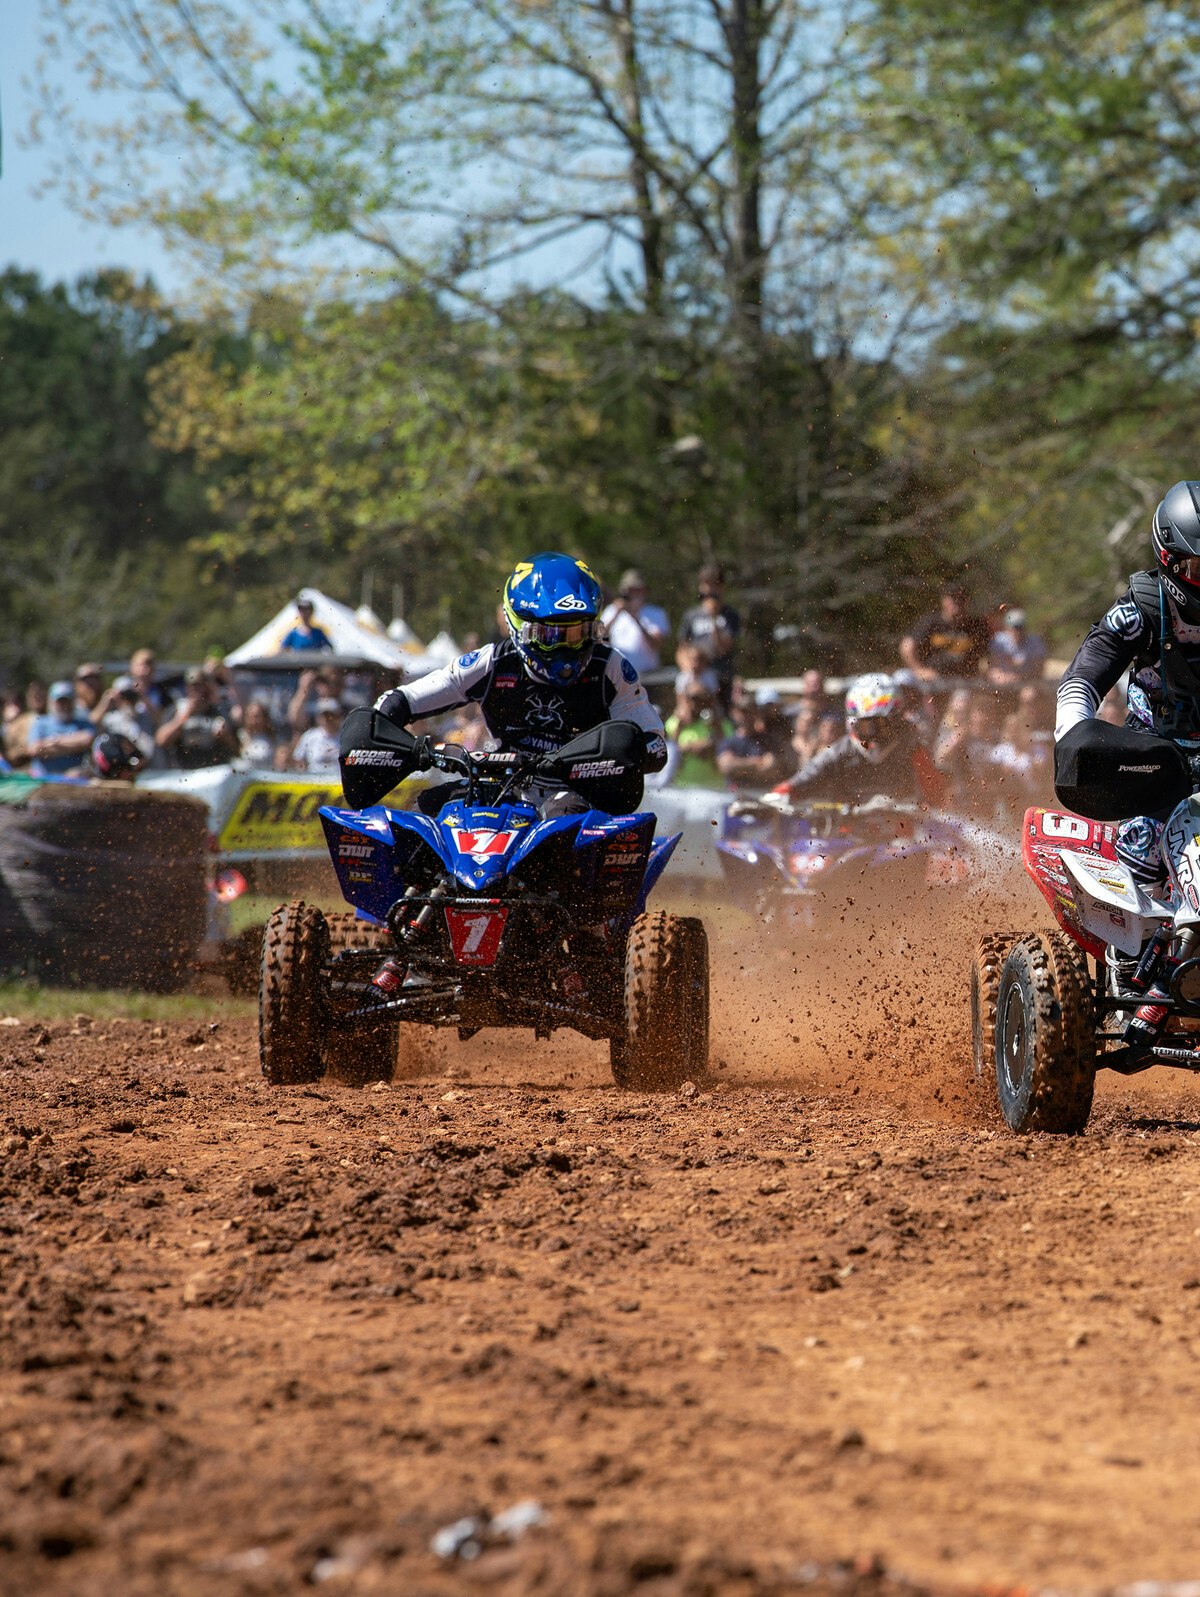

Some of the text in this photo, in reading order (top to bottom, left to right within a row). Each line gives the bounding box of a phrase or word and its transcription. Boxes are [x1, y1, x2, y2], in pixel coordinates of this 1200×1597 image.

[349, 750, 395, 759] MOOSE
[354, 758, 403, 768] RACING
[572, 760, 615, 772] MOOSE
[578, 766, 625, 778] RACING
[1042, 813, 1088, 841] 9
[470, 832, 497, 853] 1
[1092, 902, 1123, 916] ACTION
[461, 916, 491, 952] 1
[1144, 953, 1157, 972] Elka
[1130, 1017, 1157, 1035] Elka
